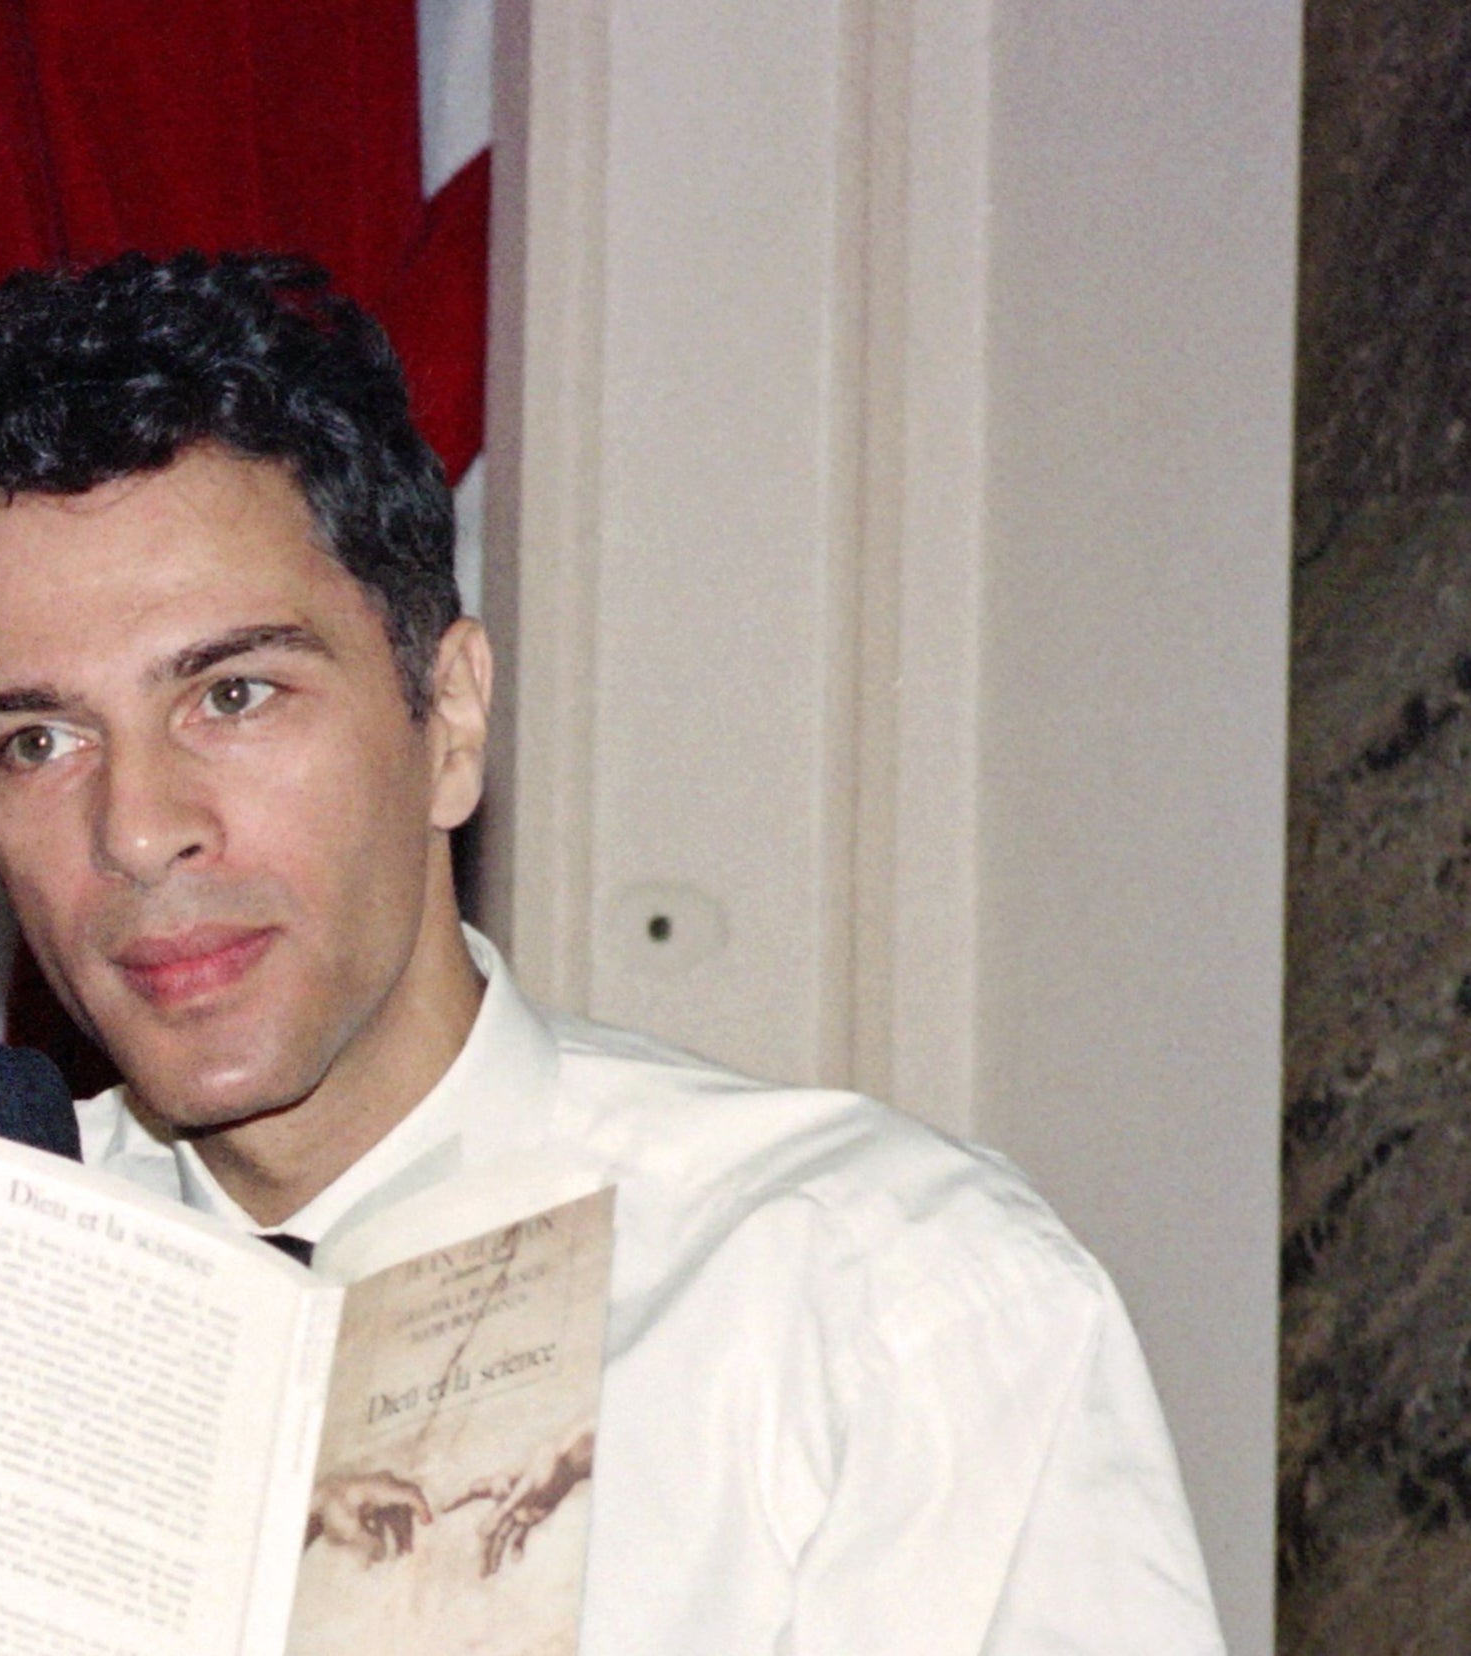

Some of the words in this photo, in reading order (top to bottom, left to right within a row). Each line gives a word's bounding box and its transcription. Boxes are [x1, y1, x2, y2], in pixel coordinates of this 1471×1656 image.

[8, 1177, 68, 1223] Dieu
[76, 1210, 99, 1232] et
[104, 1212, 125, 1243] la
[133, 1231, 216, 1279] science
[367, 1385, 419, 1425] Dieu
[479, 1341, 557, 1386] science
